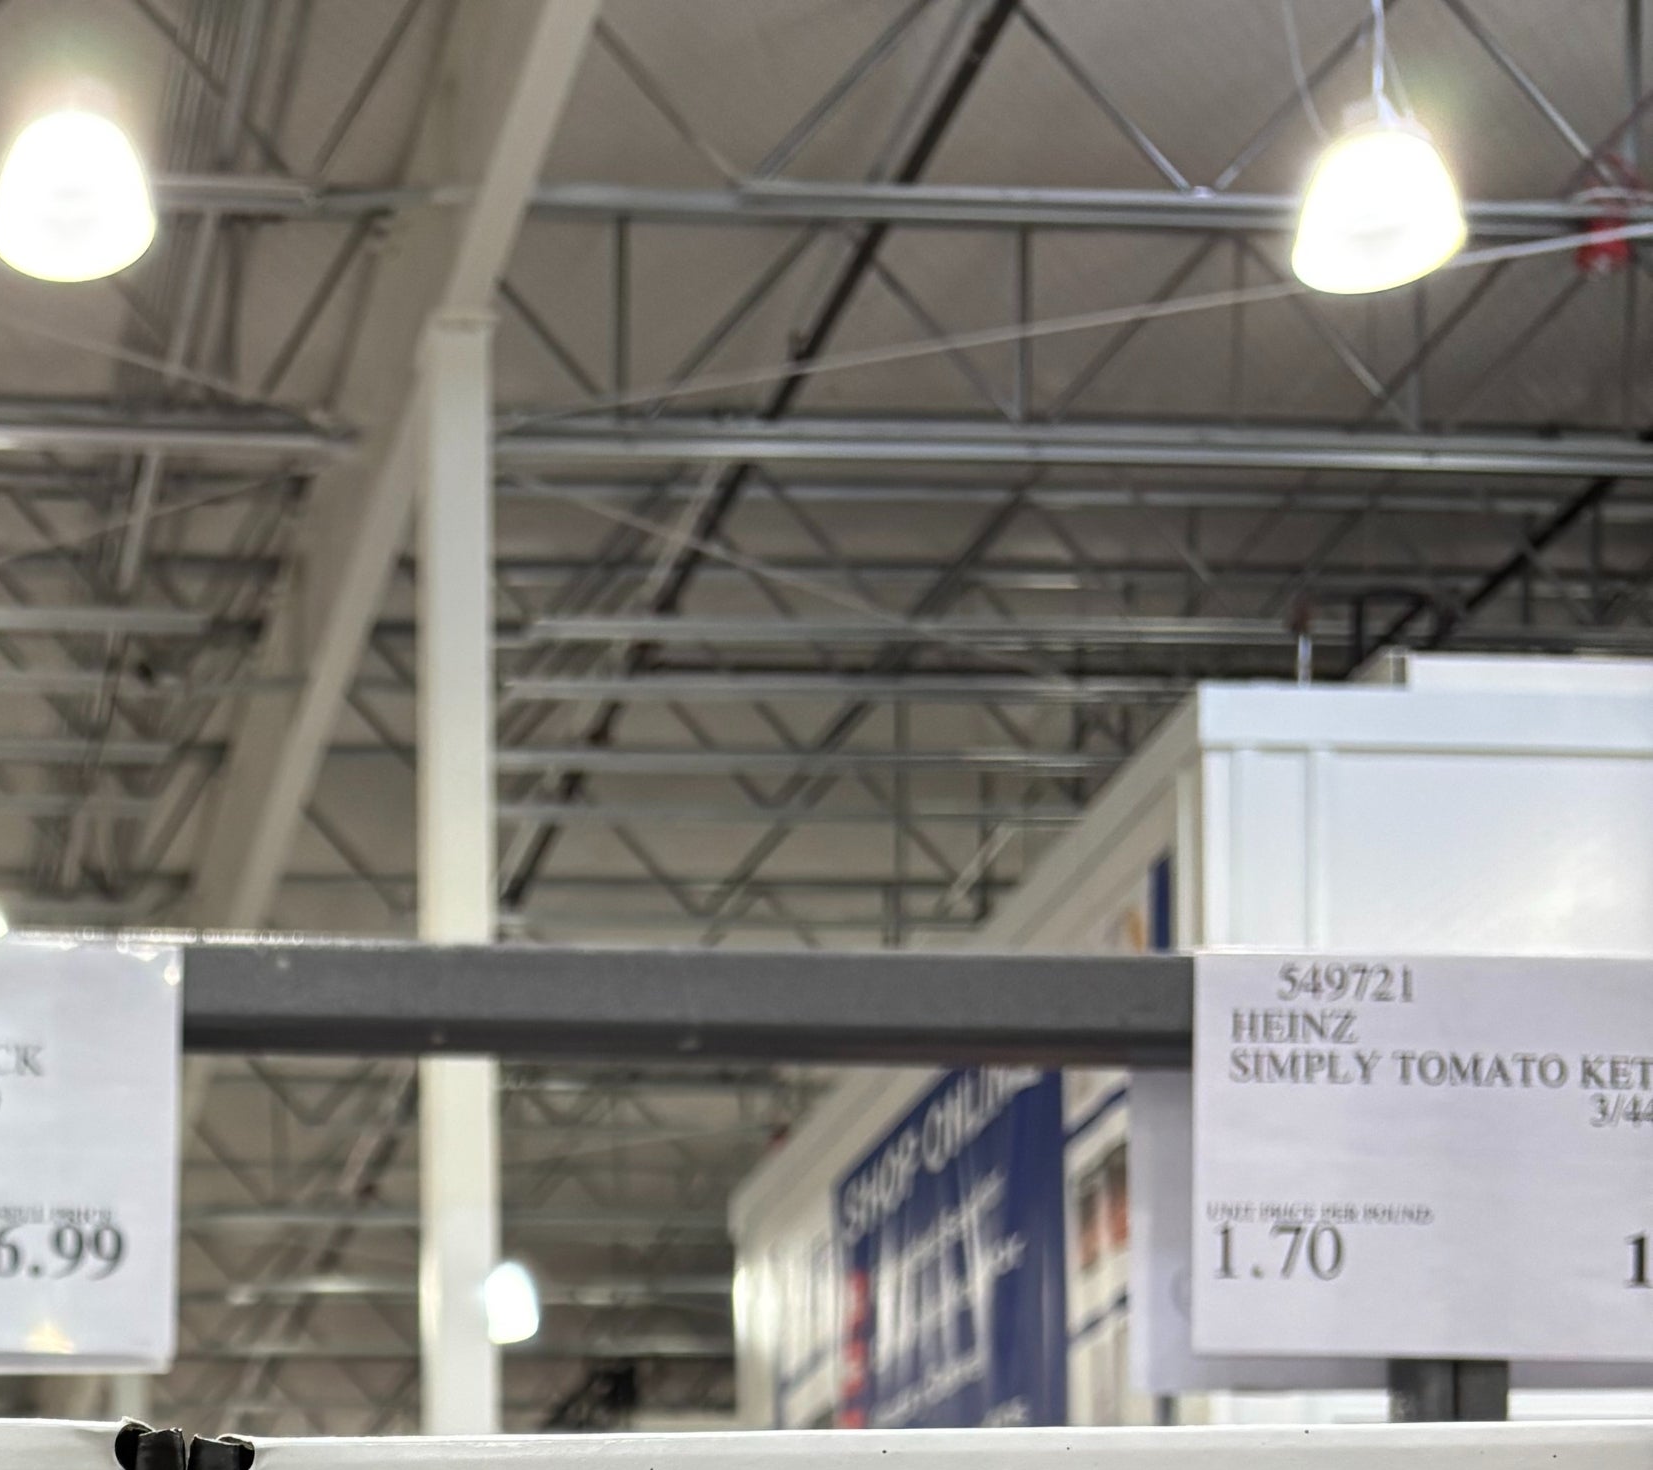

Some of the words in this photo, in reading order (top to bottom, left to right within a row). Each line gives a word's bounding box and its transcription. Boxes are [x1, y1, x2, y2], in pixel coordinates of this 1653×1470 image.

[1278, 962, 1414, 1001] 549721
[1231, 1009, 1359, 1046] HEINZ
[1229, 1048, 1381, 1086] SIMPLY
[1391, 1051, 1567, 1088] TOMATO
[1580, 1056, 1653, 1091] KET
[1213, 1224, 1343, 1281] 1.70
